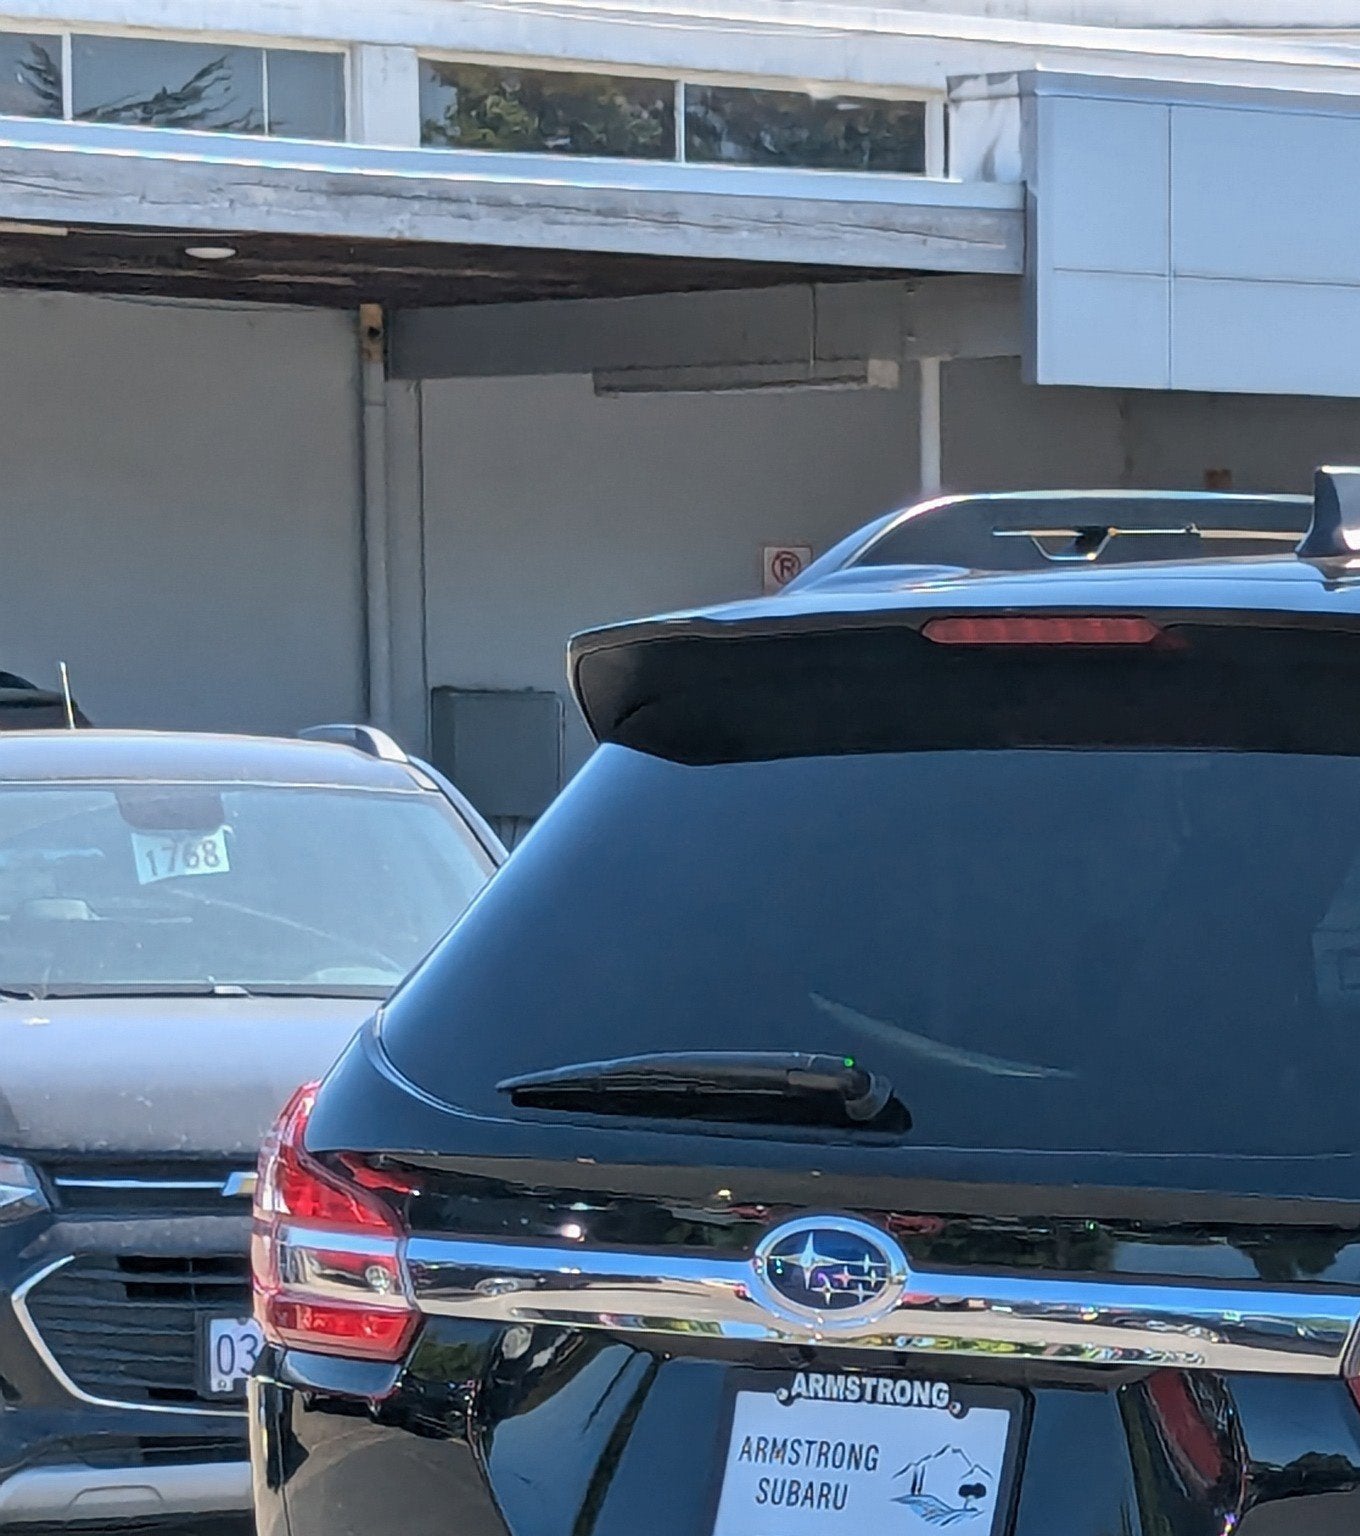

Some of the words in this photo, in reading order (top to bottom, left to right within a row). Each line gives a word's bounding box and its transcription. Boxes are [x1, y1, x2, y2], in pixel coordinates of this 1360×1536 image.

[145, 838, 220, 876] 1768
[216, 1333, 259, 1376] 03
[790, 1372, 951, 1410] ARMSTRONG
[738, 1435, 880, 1472] ARMSTRONG
[754, 1477, 849, 1511] SUBARU
